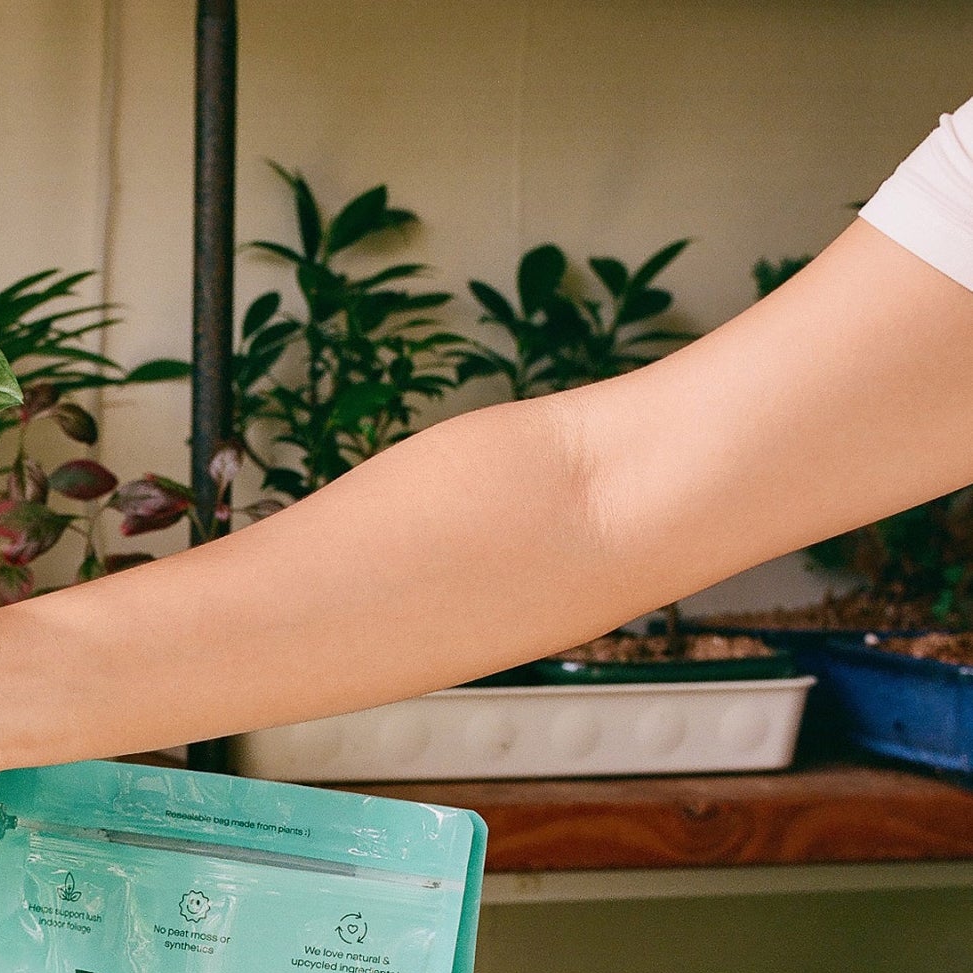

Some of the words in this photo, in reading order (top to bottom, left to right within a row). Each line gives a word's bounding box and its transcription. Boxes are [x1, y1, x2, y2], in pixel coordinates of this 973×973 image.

[165, 809, 212, 823] Resealable
[213, 815, 229, 827] bag
[231, 818, 255, 829] made
[256, 821, 277, 832] from
[278, 824, 304, 836] plants
[28, 903, 53, 916] Helps
[55, 907, 85, 922] support
[85, 911, 102, 923] lush
[38, 917, 67, 929] indoor
[66, 921, 92, 934] foliage
[153, 924, 167, 935] No
[168, 926, 189, 939] peat
[190, 931, 218, 943] moss
[220, 935, 231, 944] or
[164, 939, 214, 955] synthetics
[304, 945, 321, 956] We
[322, 948, 344, 959] love
[346, 952, 381, 964] natural
[382, 956, 390, 965] &
[291, 957, 338, 971] upcycled
